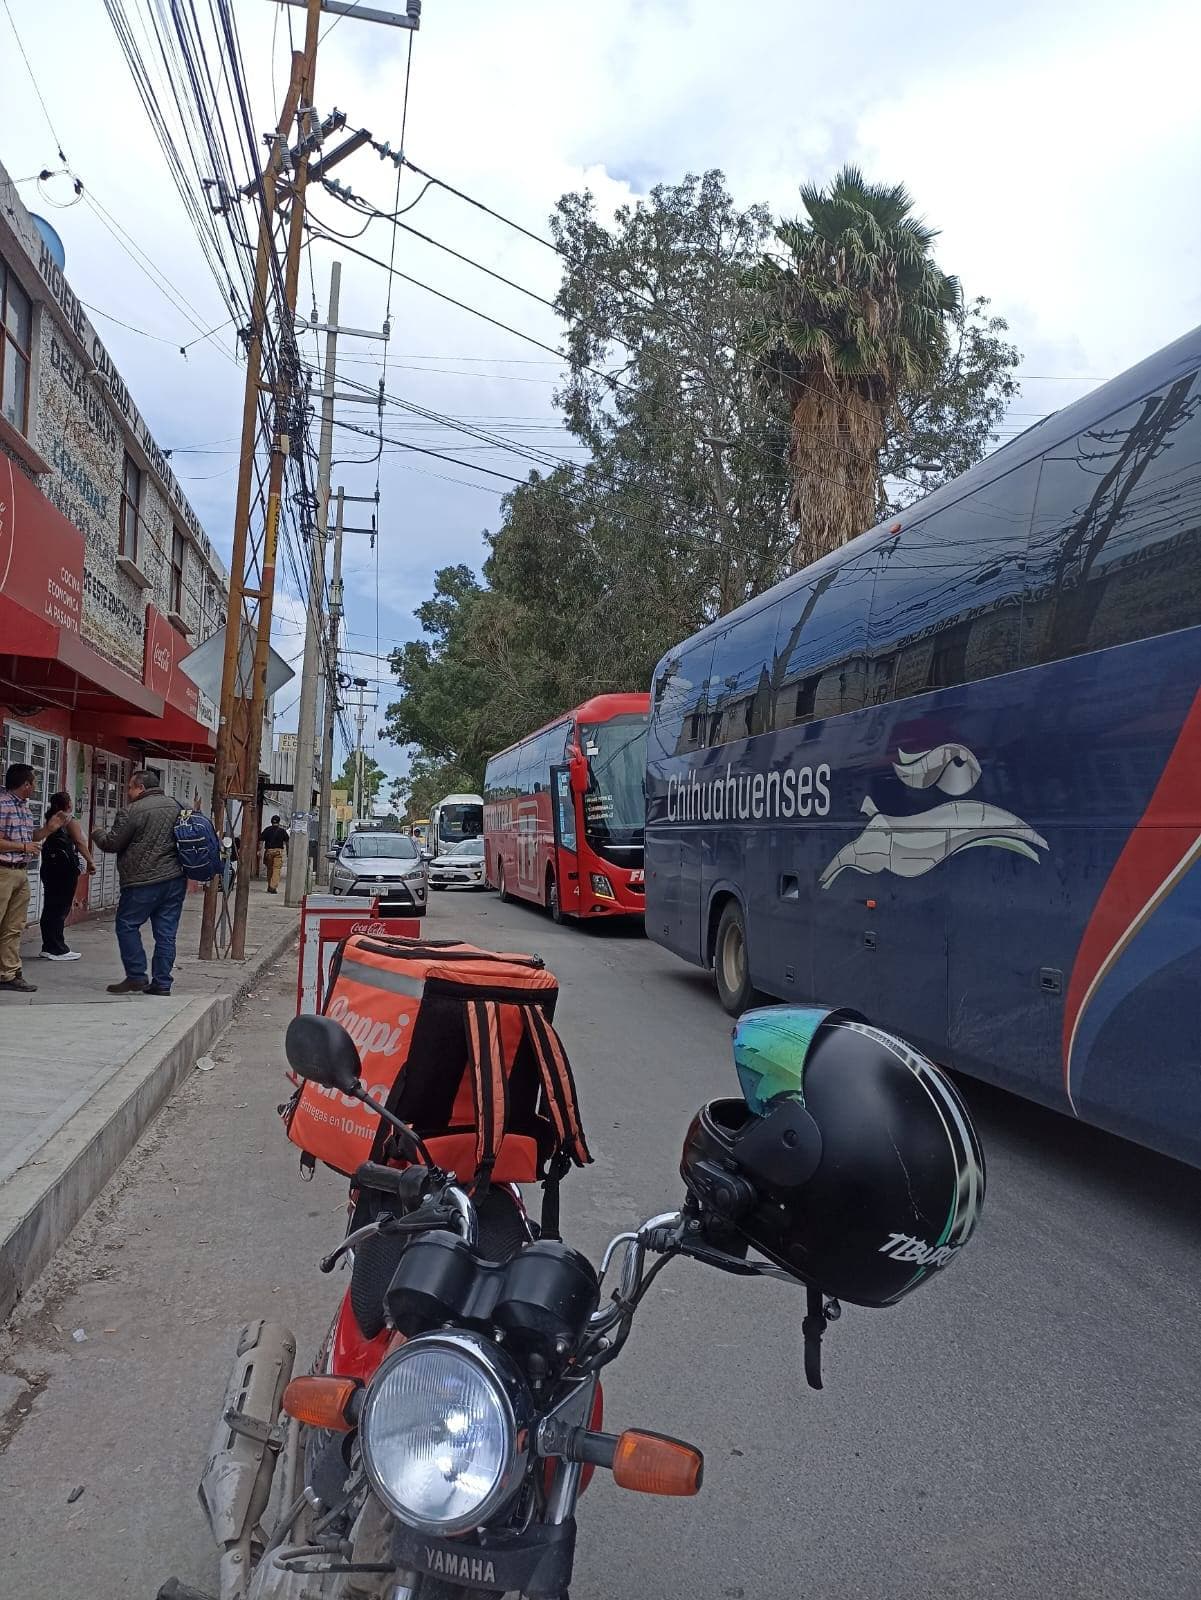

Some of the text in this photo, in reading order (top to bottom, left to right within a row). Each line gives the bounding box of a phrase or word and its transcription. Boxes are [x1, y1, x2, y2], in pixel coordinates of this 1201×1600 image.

[60, 566, 80, 593] COCINA
[45, 599, 78, 633] LA PASADITA
[666, 763, 832, 823] Chihuahuenses
[329, 1115, 341, 1127] en
[341, 1117, 354, 1134] 10
[424, 1544, 496, 1583] YAMAHA
